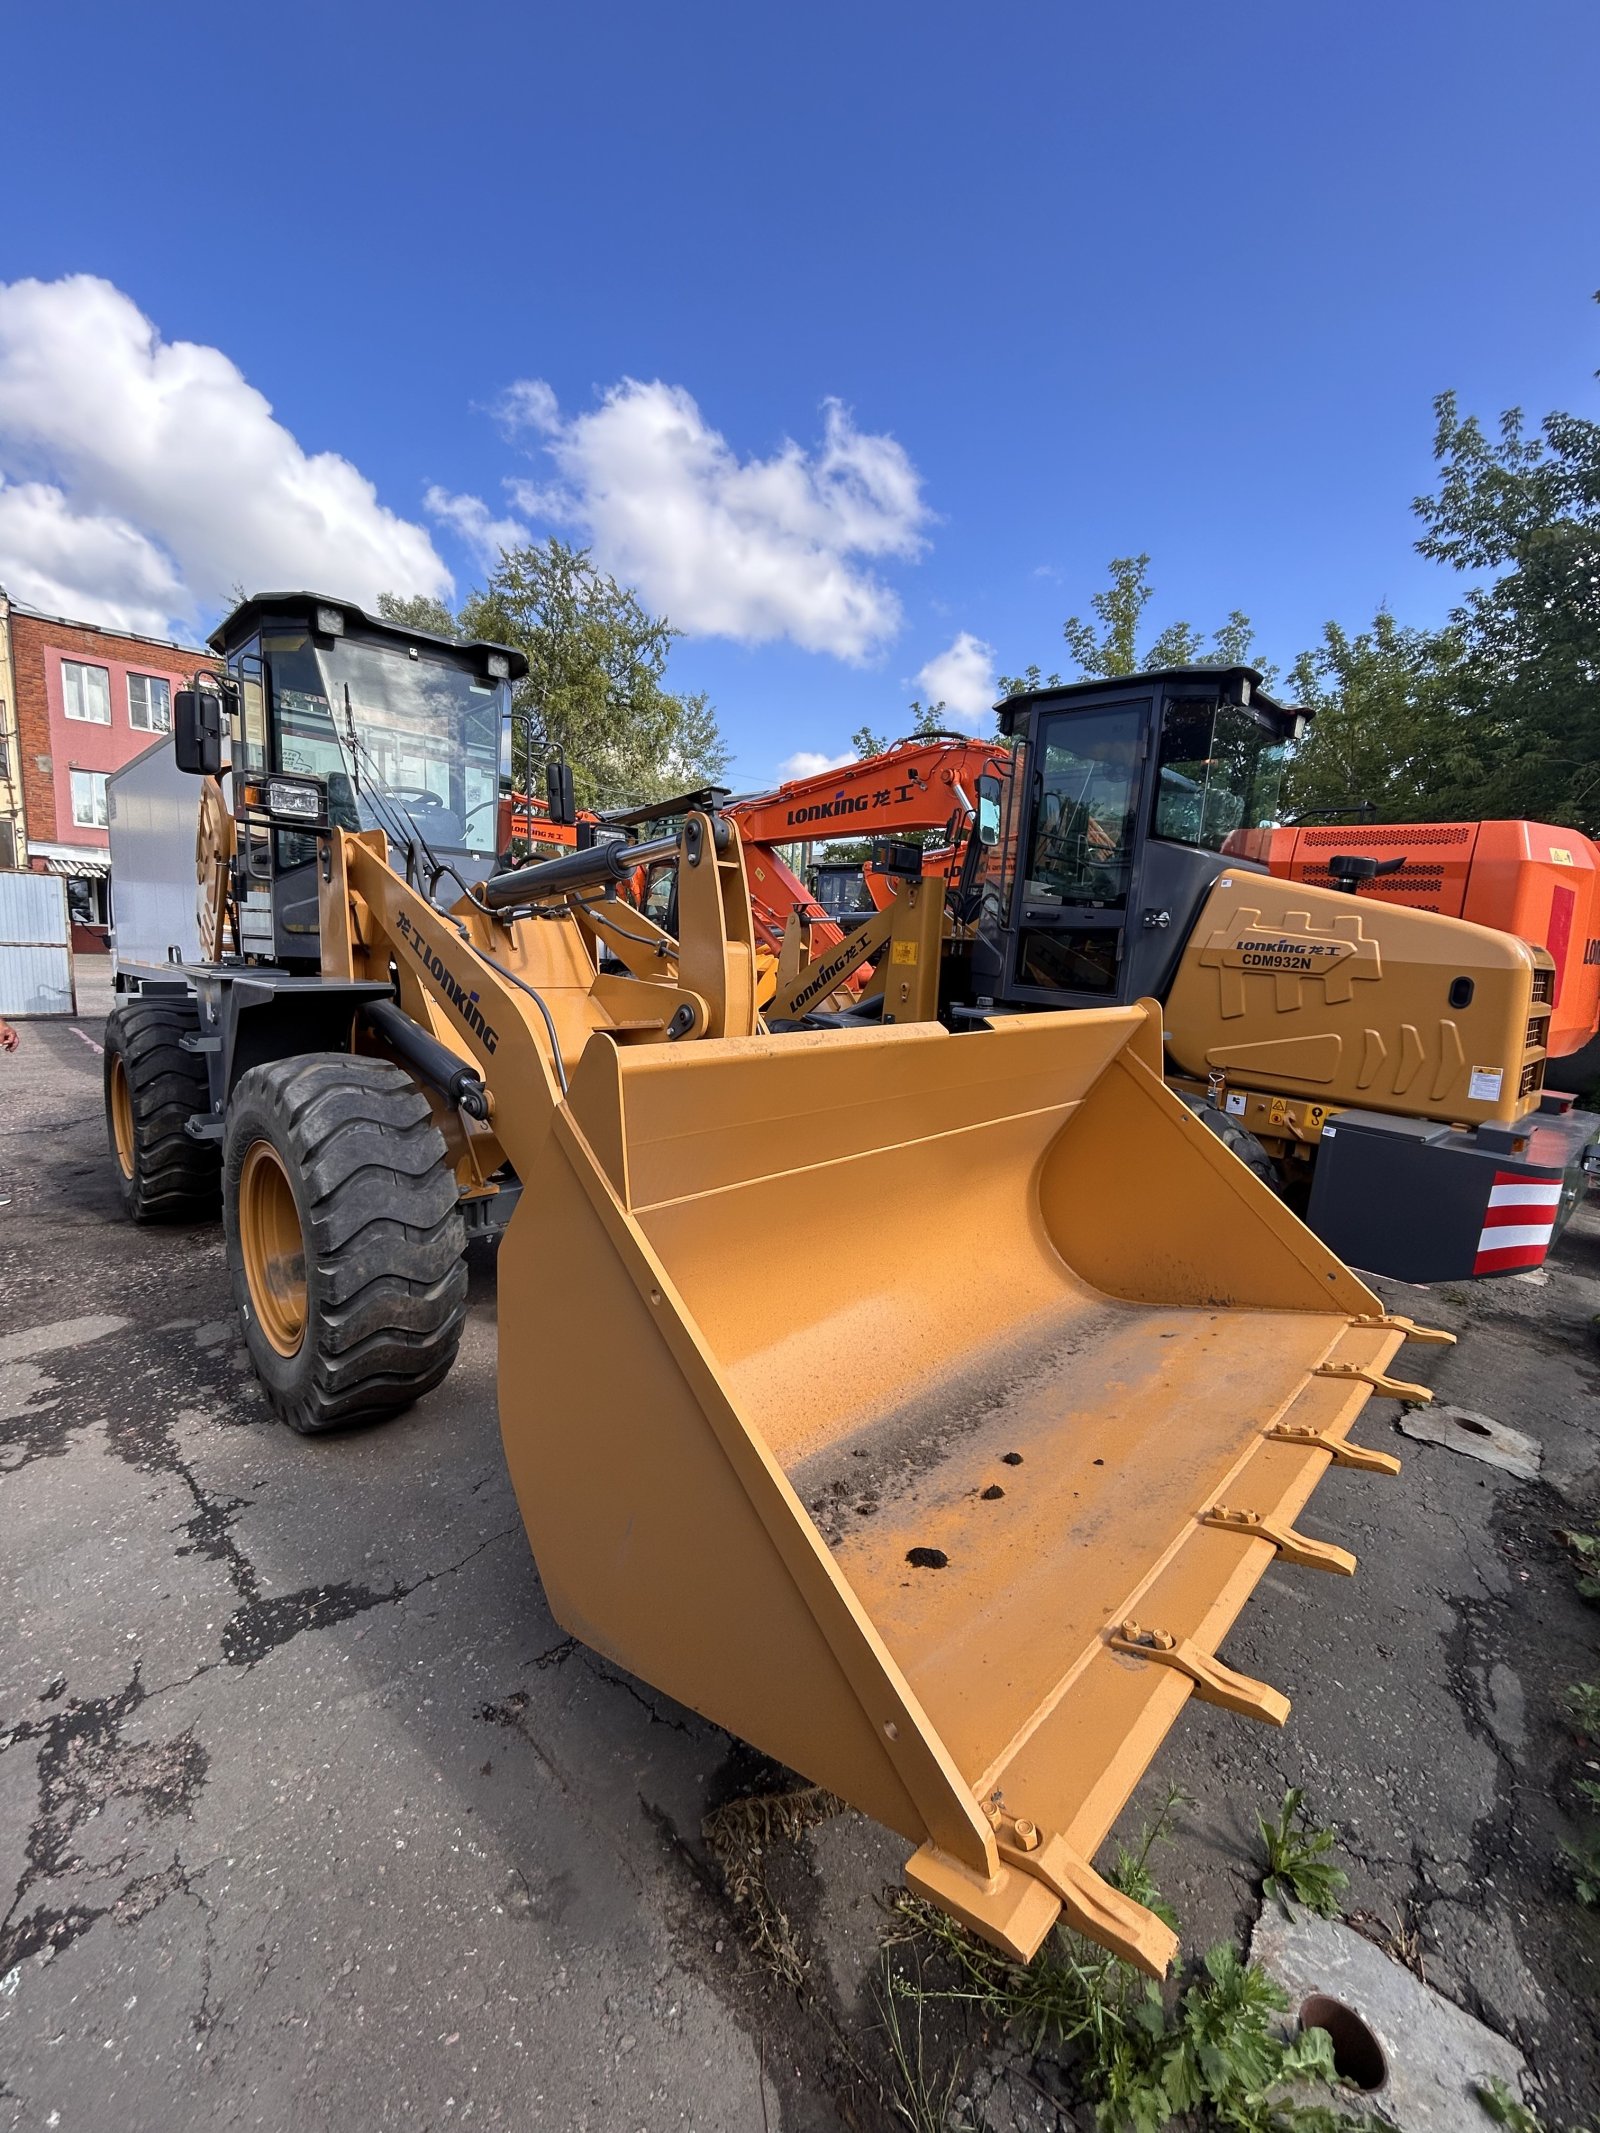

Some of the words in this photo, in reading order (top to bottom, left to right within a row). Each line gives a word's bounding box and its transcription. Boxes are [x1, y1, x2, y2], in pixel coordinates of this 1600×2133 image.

[786, 790, 868, 825] LONKING
[872, 783, 914, 808] 龙工
[512, 825, 547, 838] LONING
[1236, 940, 1306, 954] LONKING
[1308, 945, 1341, 956] 龙工
[1242, 953, 1312, 969] CDM932N
[396, 911, 425, 958] 龙工
[421, 945, 499, 1056] LONKING
[789, 955, 846, 1013] LONKING
